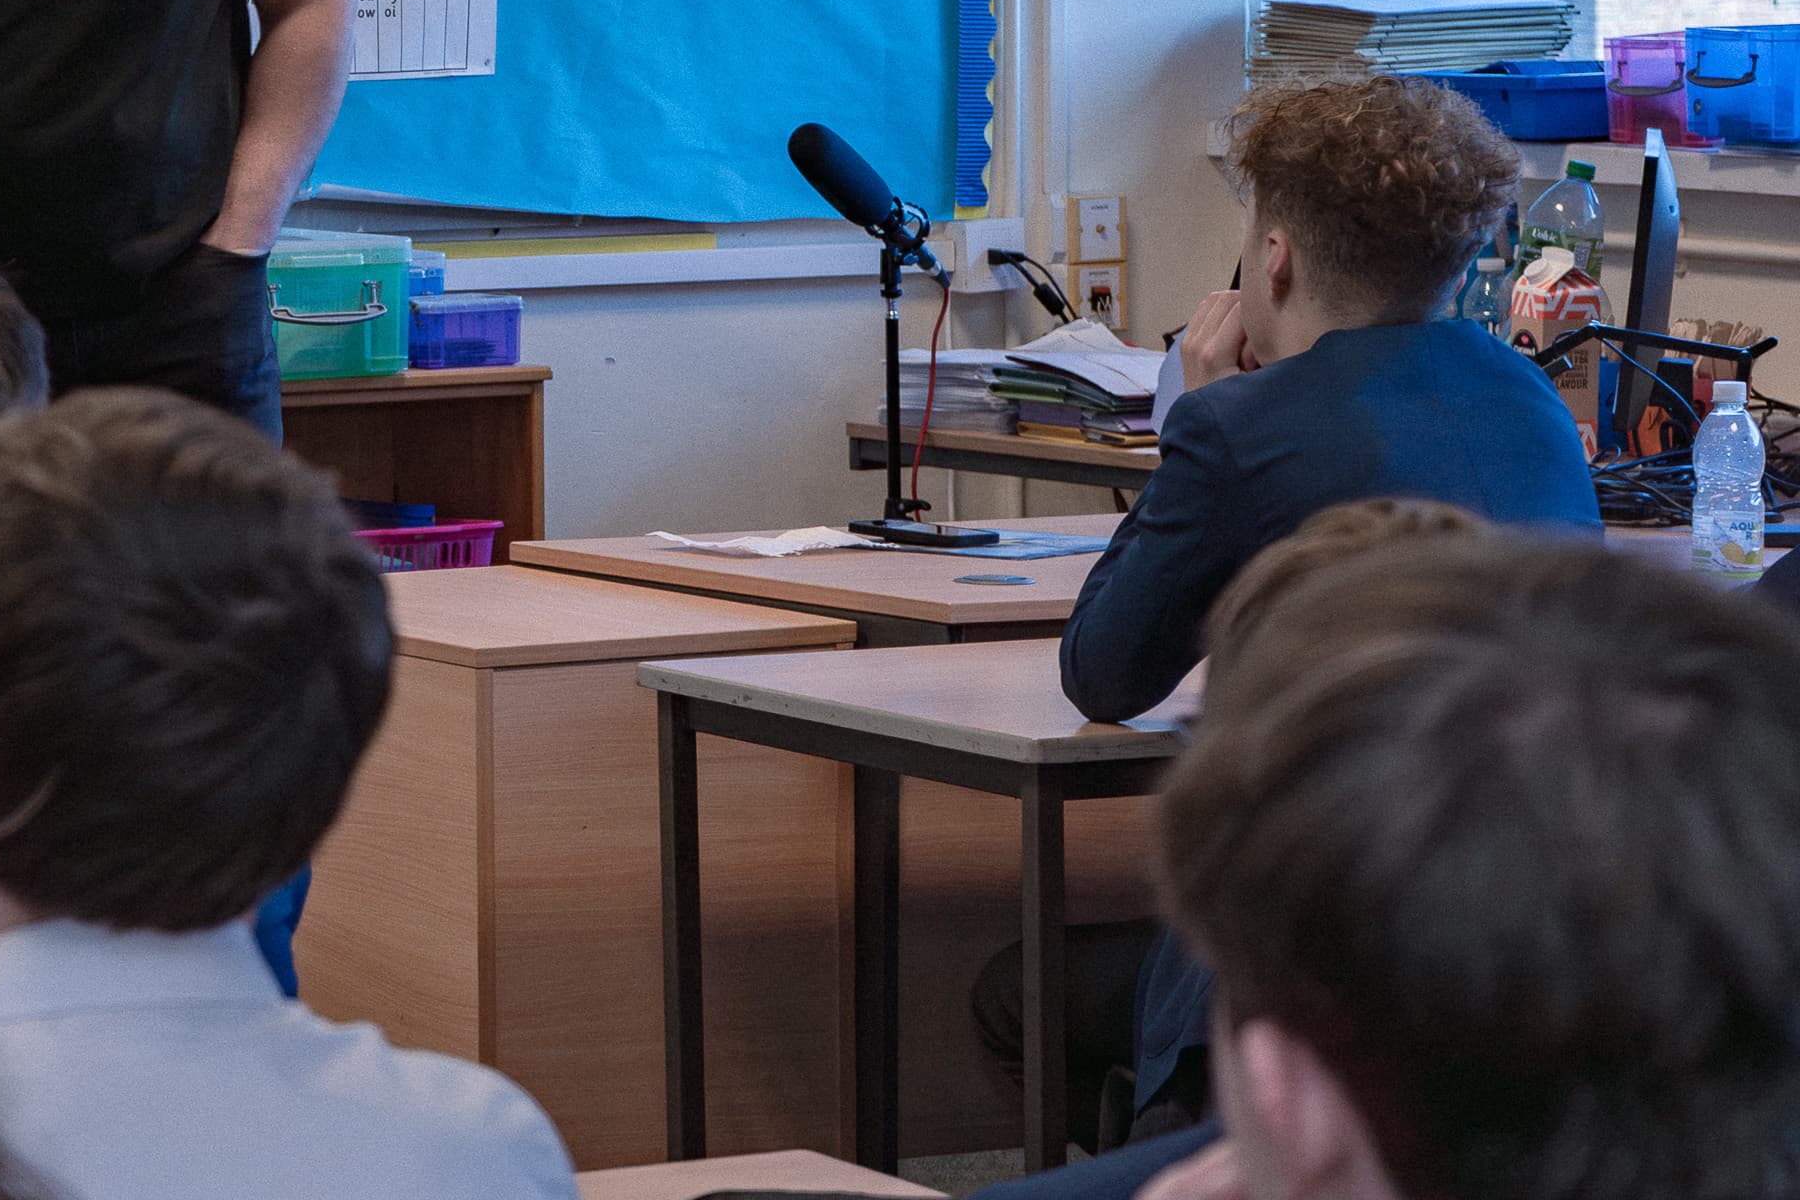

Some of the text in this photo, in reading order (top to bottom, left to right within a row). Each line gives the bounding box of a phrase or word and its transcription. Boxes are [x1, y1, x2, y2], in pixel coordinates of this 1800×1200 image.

[358, 6, 396, 18] ow oi
[1556, 380, 1588, 390] LAVOUR
